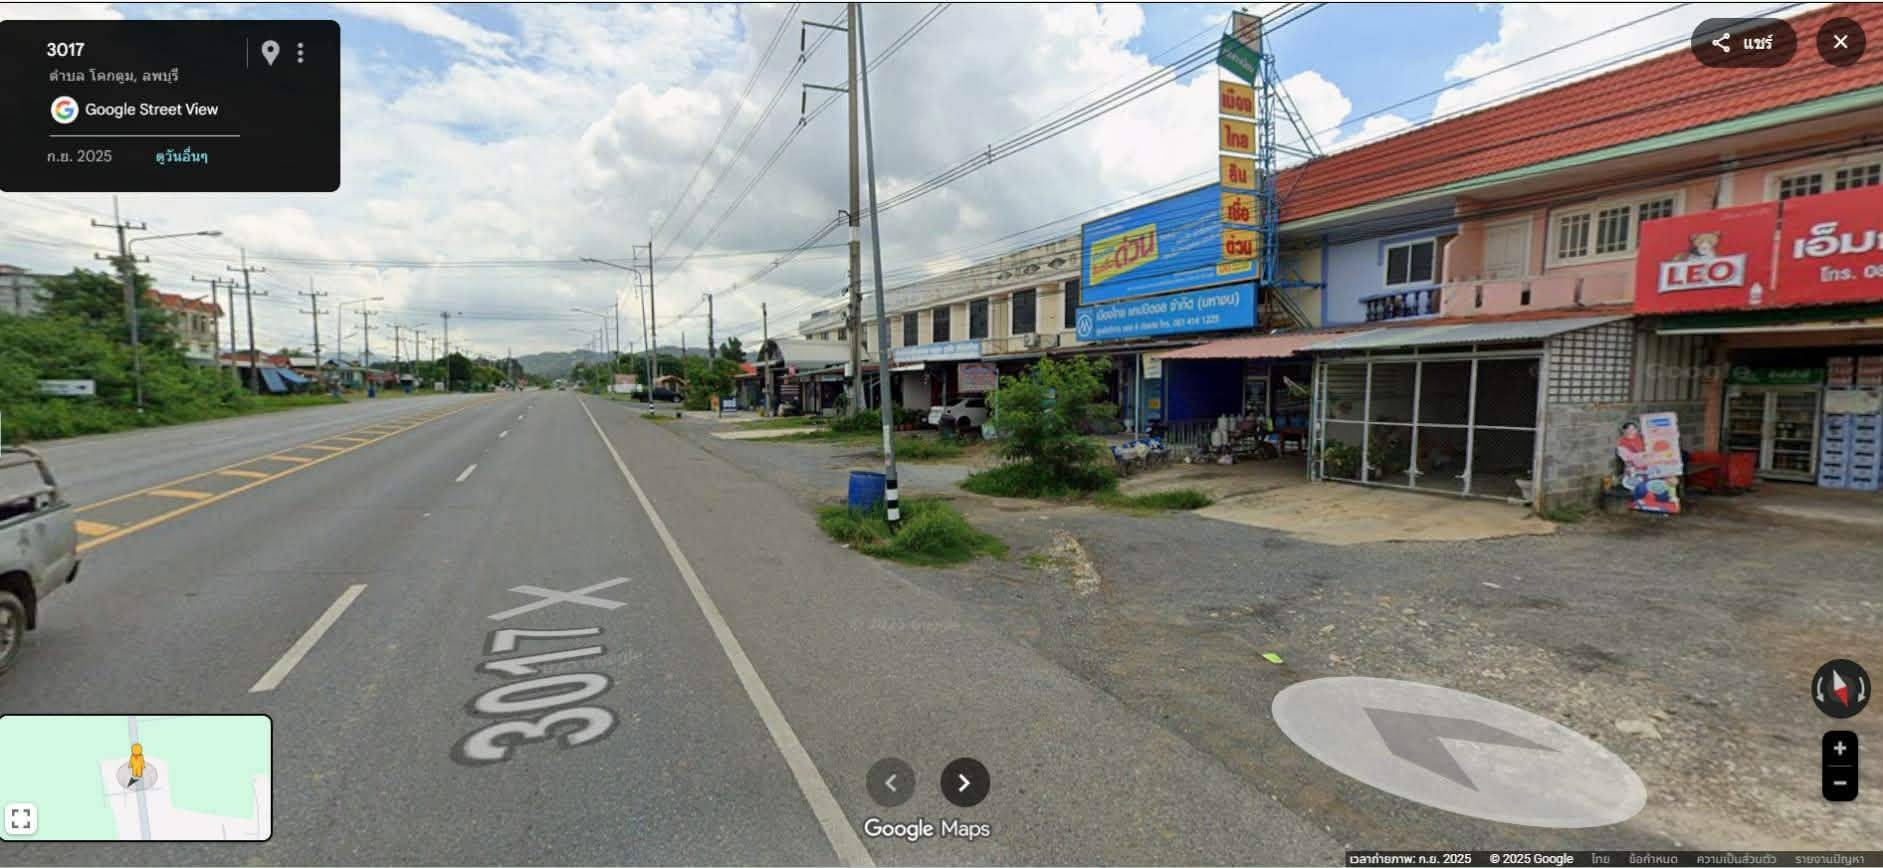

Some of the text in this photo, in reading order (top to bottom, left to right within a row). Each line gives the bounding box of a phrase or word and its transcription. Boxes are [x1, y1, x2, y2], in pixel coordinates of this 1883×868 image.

[1225, 234, 1252, 255] ด่วน
[1793, 221, 1883, 259] เอ็ม
[1668, 261, 1735, 285] LEO
